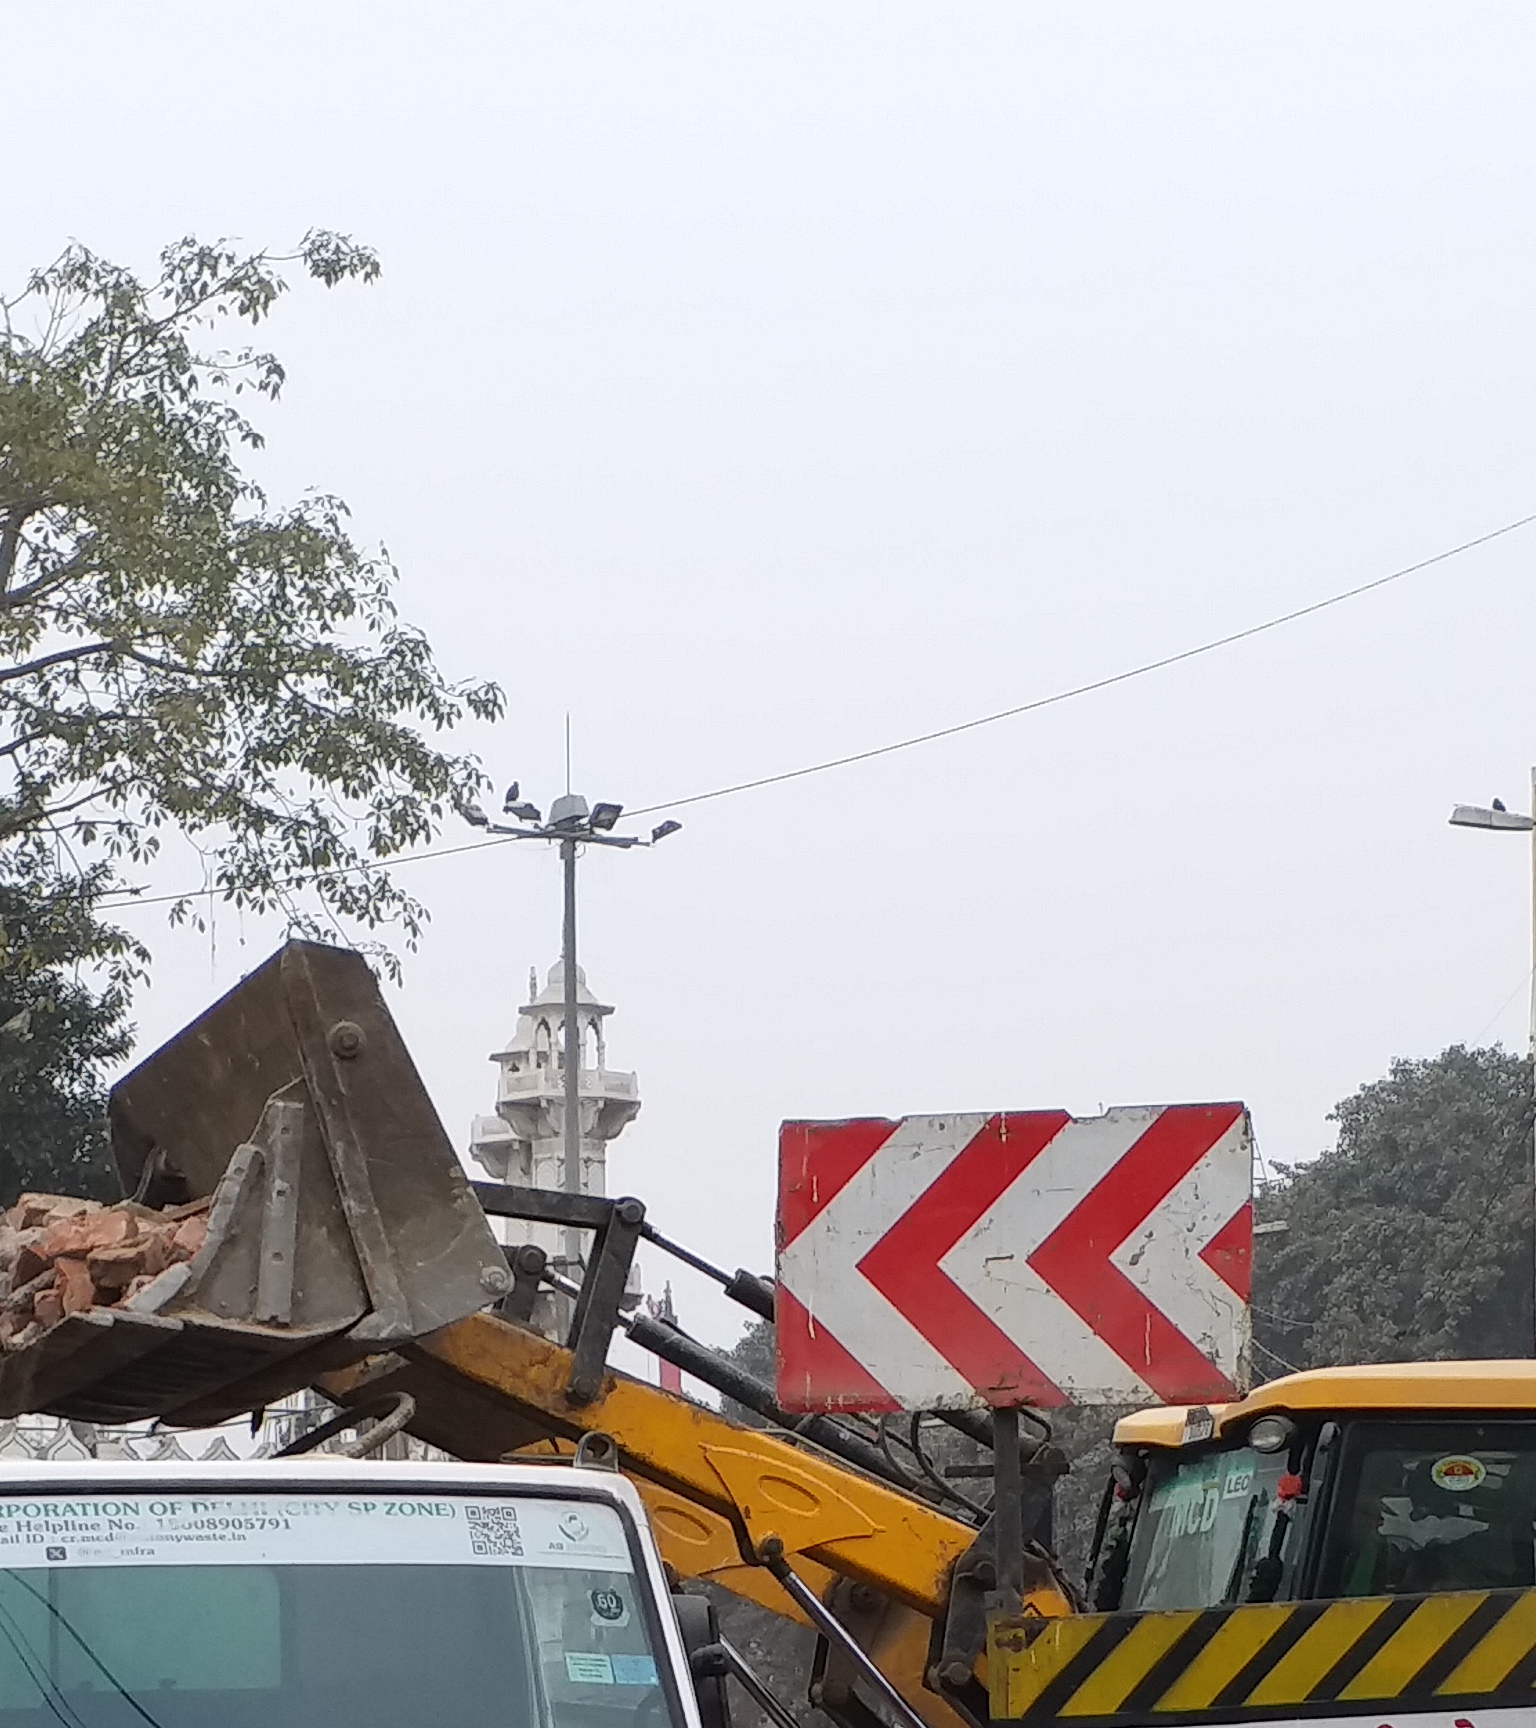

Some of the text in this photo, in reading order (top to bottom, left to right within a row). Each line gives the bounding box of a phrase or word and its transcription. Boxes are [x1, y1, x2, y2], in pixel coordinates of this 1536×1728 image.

[149, 1502, 183, 1516] OF
[347, 1502, 377, 1515] SP
[384, 1502, 456, 1518] ZONE)
[1170, 1487, 1221, 1537] MCD
[16, 1518, 101, 1535] Helpline
[26, 1533, 44, 1544] ID
[596, 1593, 618, 1608] 60
